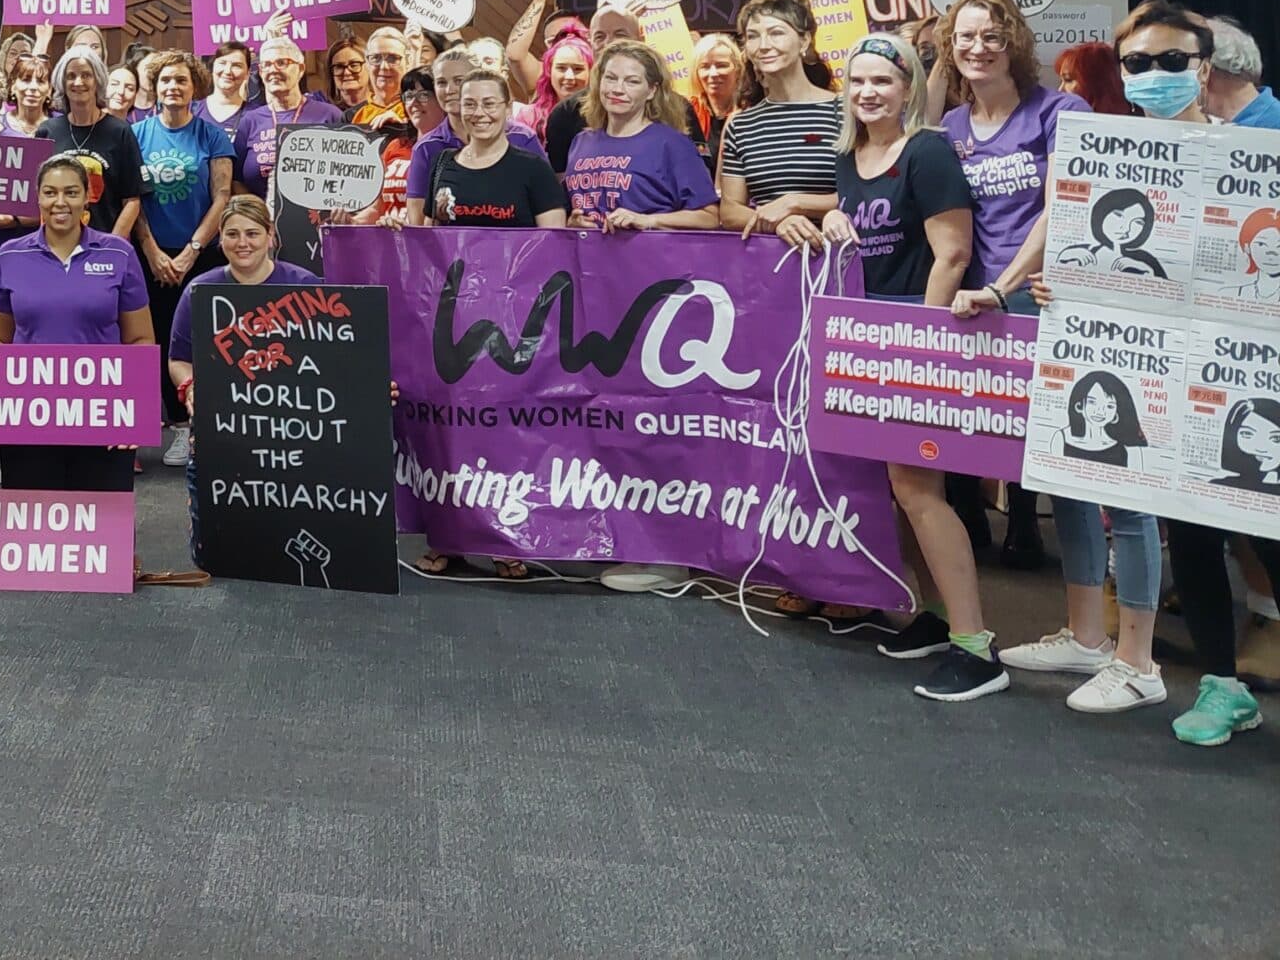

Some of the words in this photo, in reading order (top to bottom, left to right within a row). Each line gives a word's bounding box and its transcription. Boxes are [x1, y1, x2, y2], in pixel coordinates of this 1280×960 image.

[645, 18, 673, 34] MEN
[816, 11, 853, 26] OMEN
[210, 20, 308, 44] WOMN
[1033, 29, 1105, 44] cu2015!
[290, 138, 315, 152] SEX
[321, 138, 365, 156] WORKER
[1080, 132, 1180, 163] SUPPORT
[282, 157, 315, 173] SAFETY
[317, 161, 326, 174] IS
[329, 162, 376, 180] IMPORTANT
[574, 156, 631, 171] UNION
[982, 150, 1034, 172] Women
[1067, 156, 1109, 179] OUR
[1115, 162, 1184, 189] SISTERS
[303, 177, 315, 192] TO
[322, 179, 345, 197] ME!
[566, 172, 633, 191] WOMEN
[1217, 174, 1261, 197] OUR
[572, 191, 603, 209] GET
[1145, 188, 1167, 201] CAO
[1154, 213, 1176, 224] XIN
[213, 287, 351, 366] FIGHTING
[1065, 315, 1167, 349] SUPPORT
[825, 316, 1037, 362] #KeepMakingNoise
[297, 355, 321, 375] A
[1053, 340, 1094, 362] OUR
[1101, 347, 1170, 375] SISTERS
[6, 357, 123, 386] UNION
[1201, 362, 1248, 387] OUR
[230, 382, 336, 414] WORLD
[405, 400, 498, 428] ORKING
[509, 406, 624, 431] WOMEN
[824, 387, 1026, 435] #KeepMakingNois
[215, 413, 347, 443] WITHOUT
[251, 448, 304, 470] THE
[211, 479, 388, 517] PATRIARCHY
[549, 457, 712, 519] Women
[721, 484, 761, 530] at
[758, 483, 860, 553] Work
